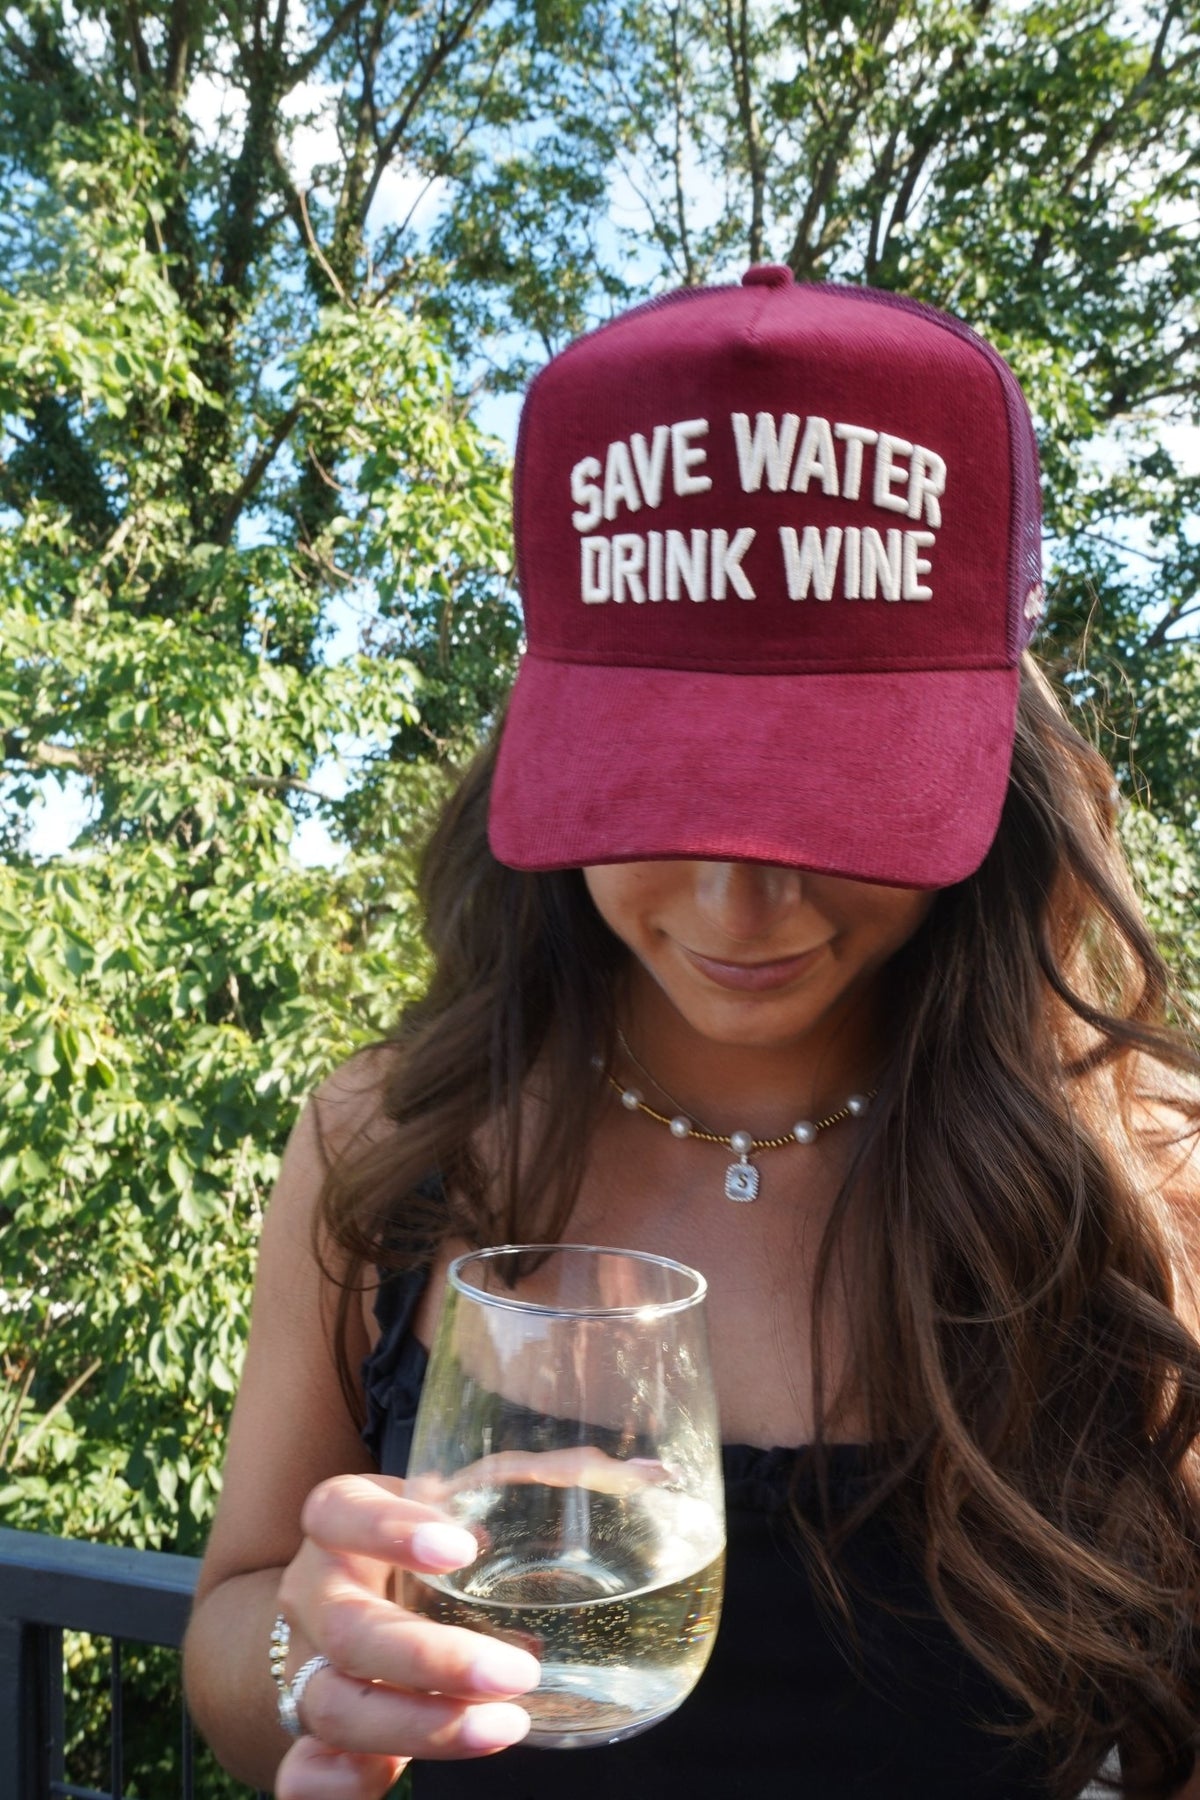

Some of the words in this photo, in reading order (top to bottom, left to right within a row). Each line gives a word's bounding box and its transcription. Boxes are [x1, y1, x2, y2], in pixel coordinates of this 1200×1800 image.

[571, 418, 712, 533] SAVE
[731, 411, 948, 529] WATER
[580, 527, 757, 604] DRINK
[779, 525, 937, 603] WINE
[737, 1172, 748, 1189] S
